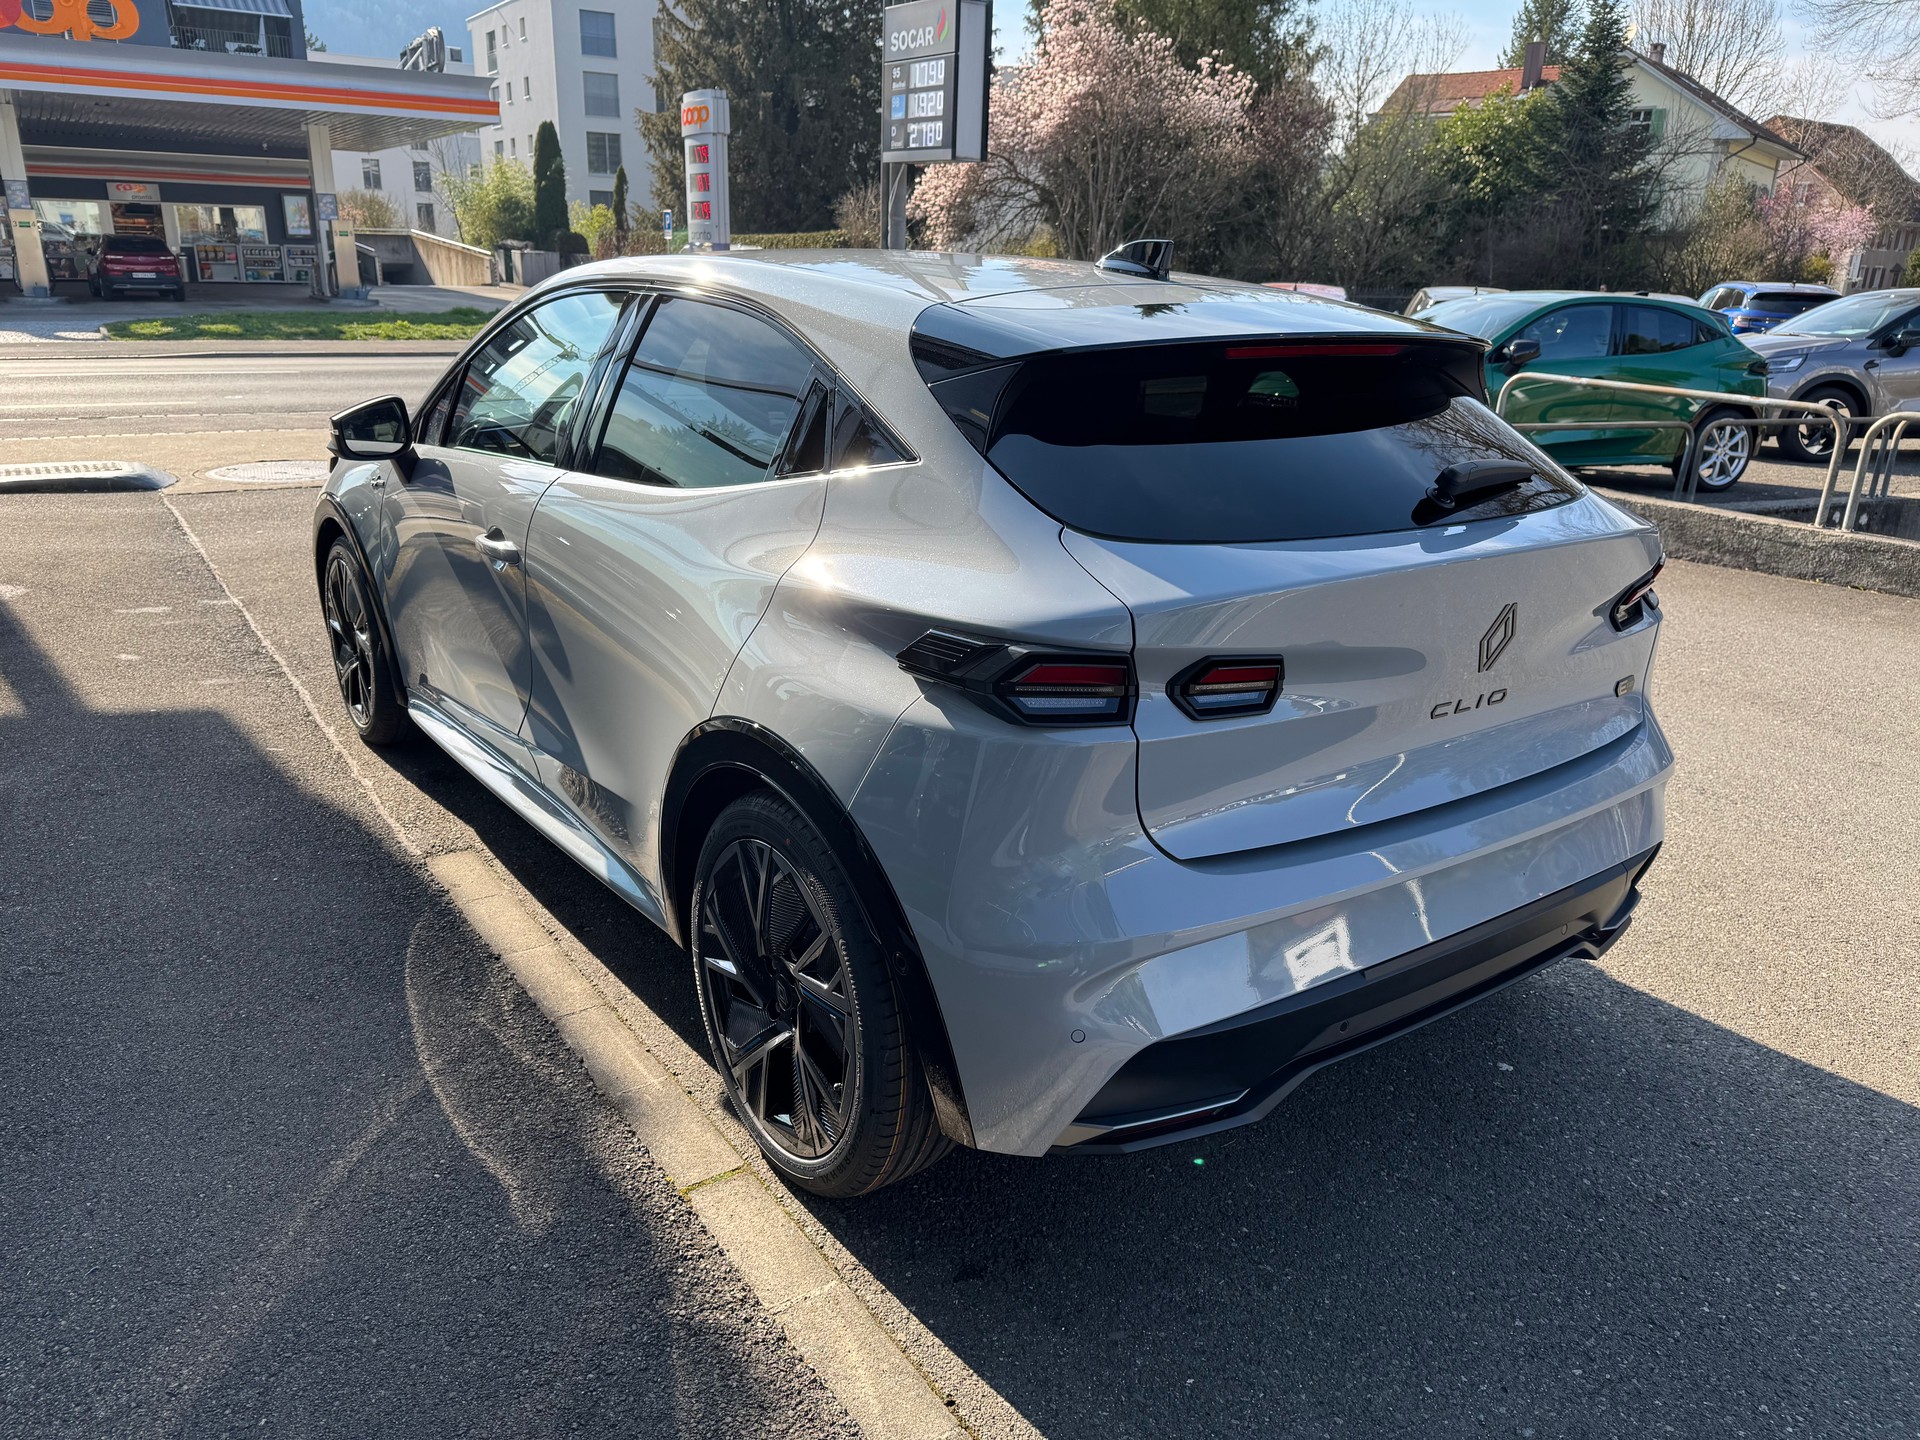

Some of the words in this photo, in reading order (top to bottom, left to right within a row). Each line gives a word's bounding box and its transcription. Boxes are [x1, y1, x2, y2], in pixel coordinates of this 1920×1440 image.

[890, 26, 934, 52] SOCAR
[682, 105, 709, 128] coop
[1430, 688, 1508, 720] CLIO
